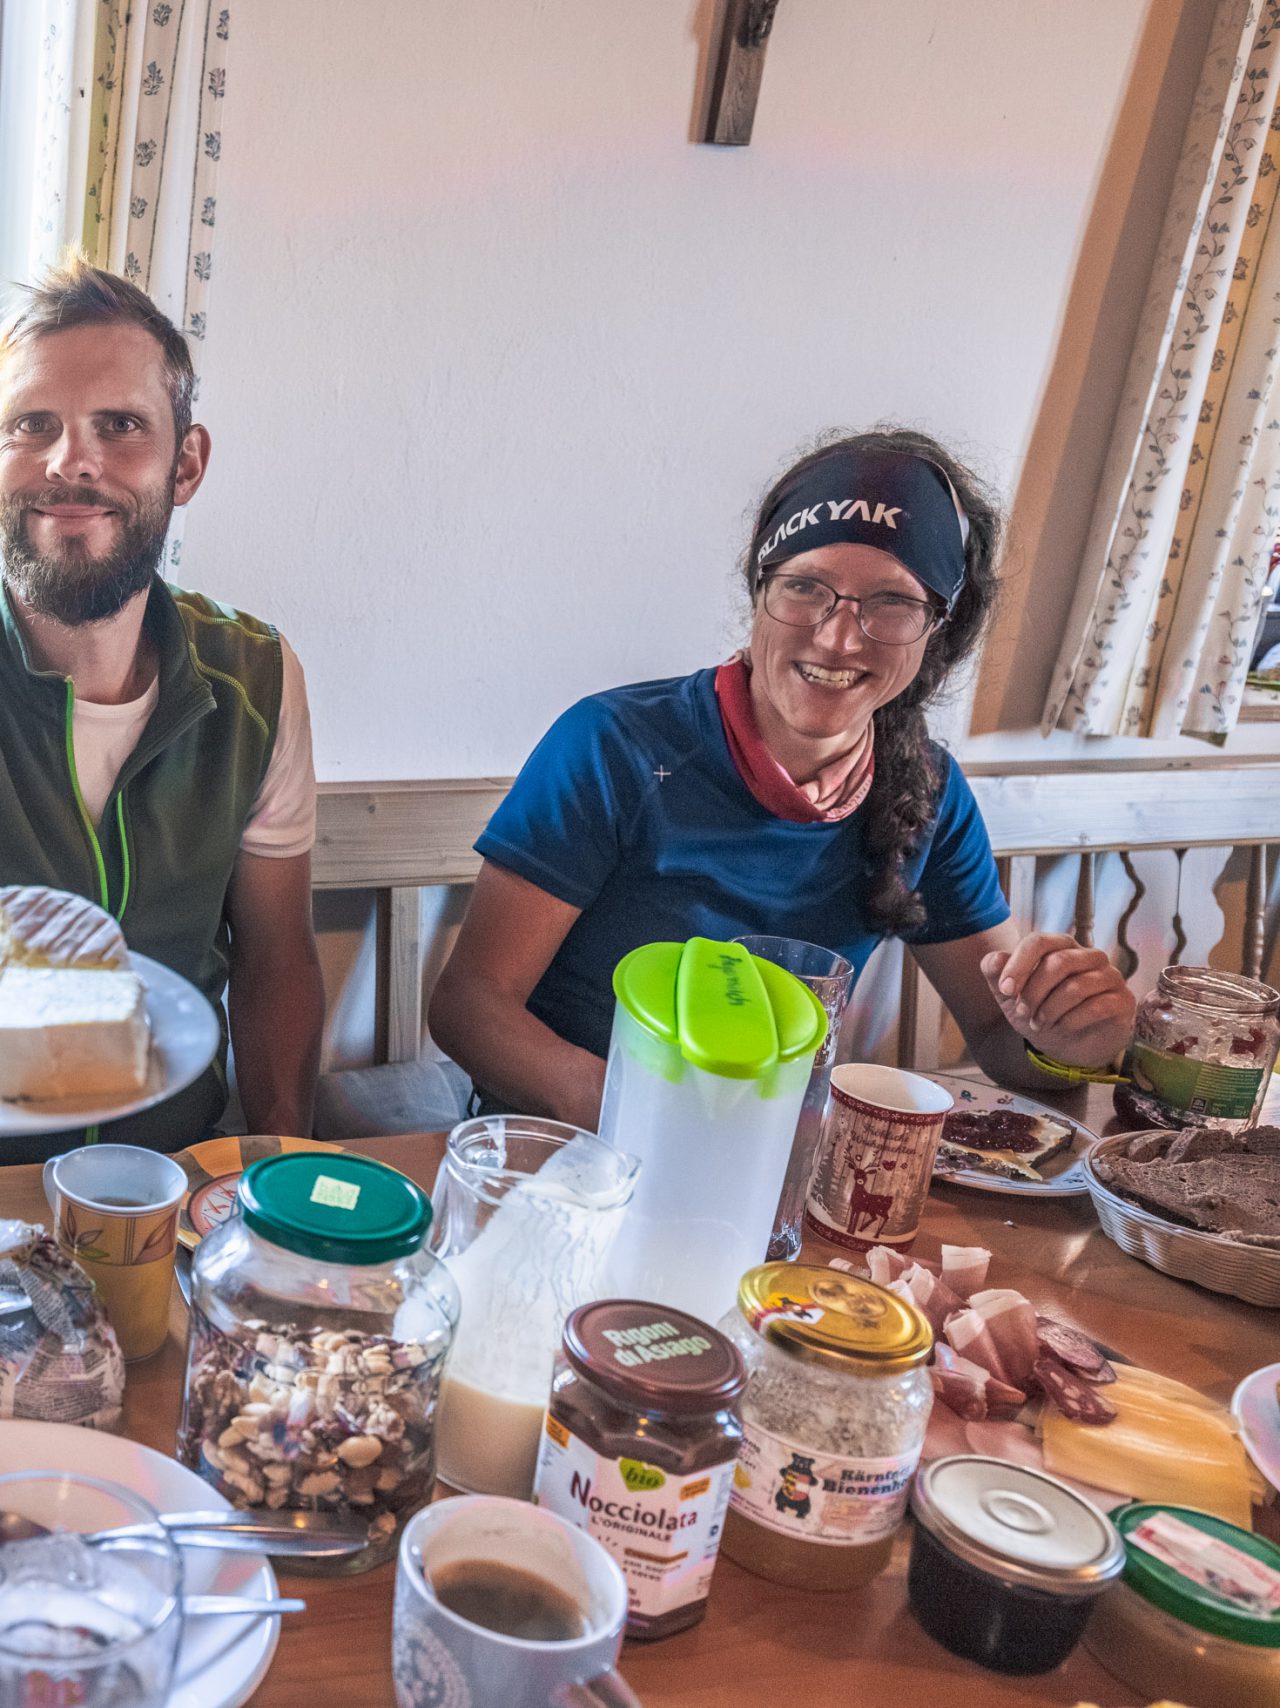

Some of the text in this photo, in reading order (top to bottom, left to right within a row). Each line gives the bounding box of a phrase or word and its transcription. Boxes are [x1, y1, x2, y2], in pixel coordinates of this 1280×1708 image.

[602, 1321, 680, 1348] Rigoni
[626, 1467, 660, 1488] bio
[571, 1470, 698, 1531] Nocciolata
[591, 1514, 672, 1543] L'ORIGINALE
